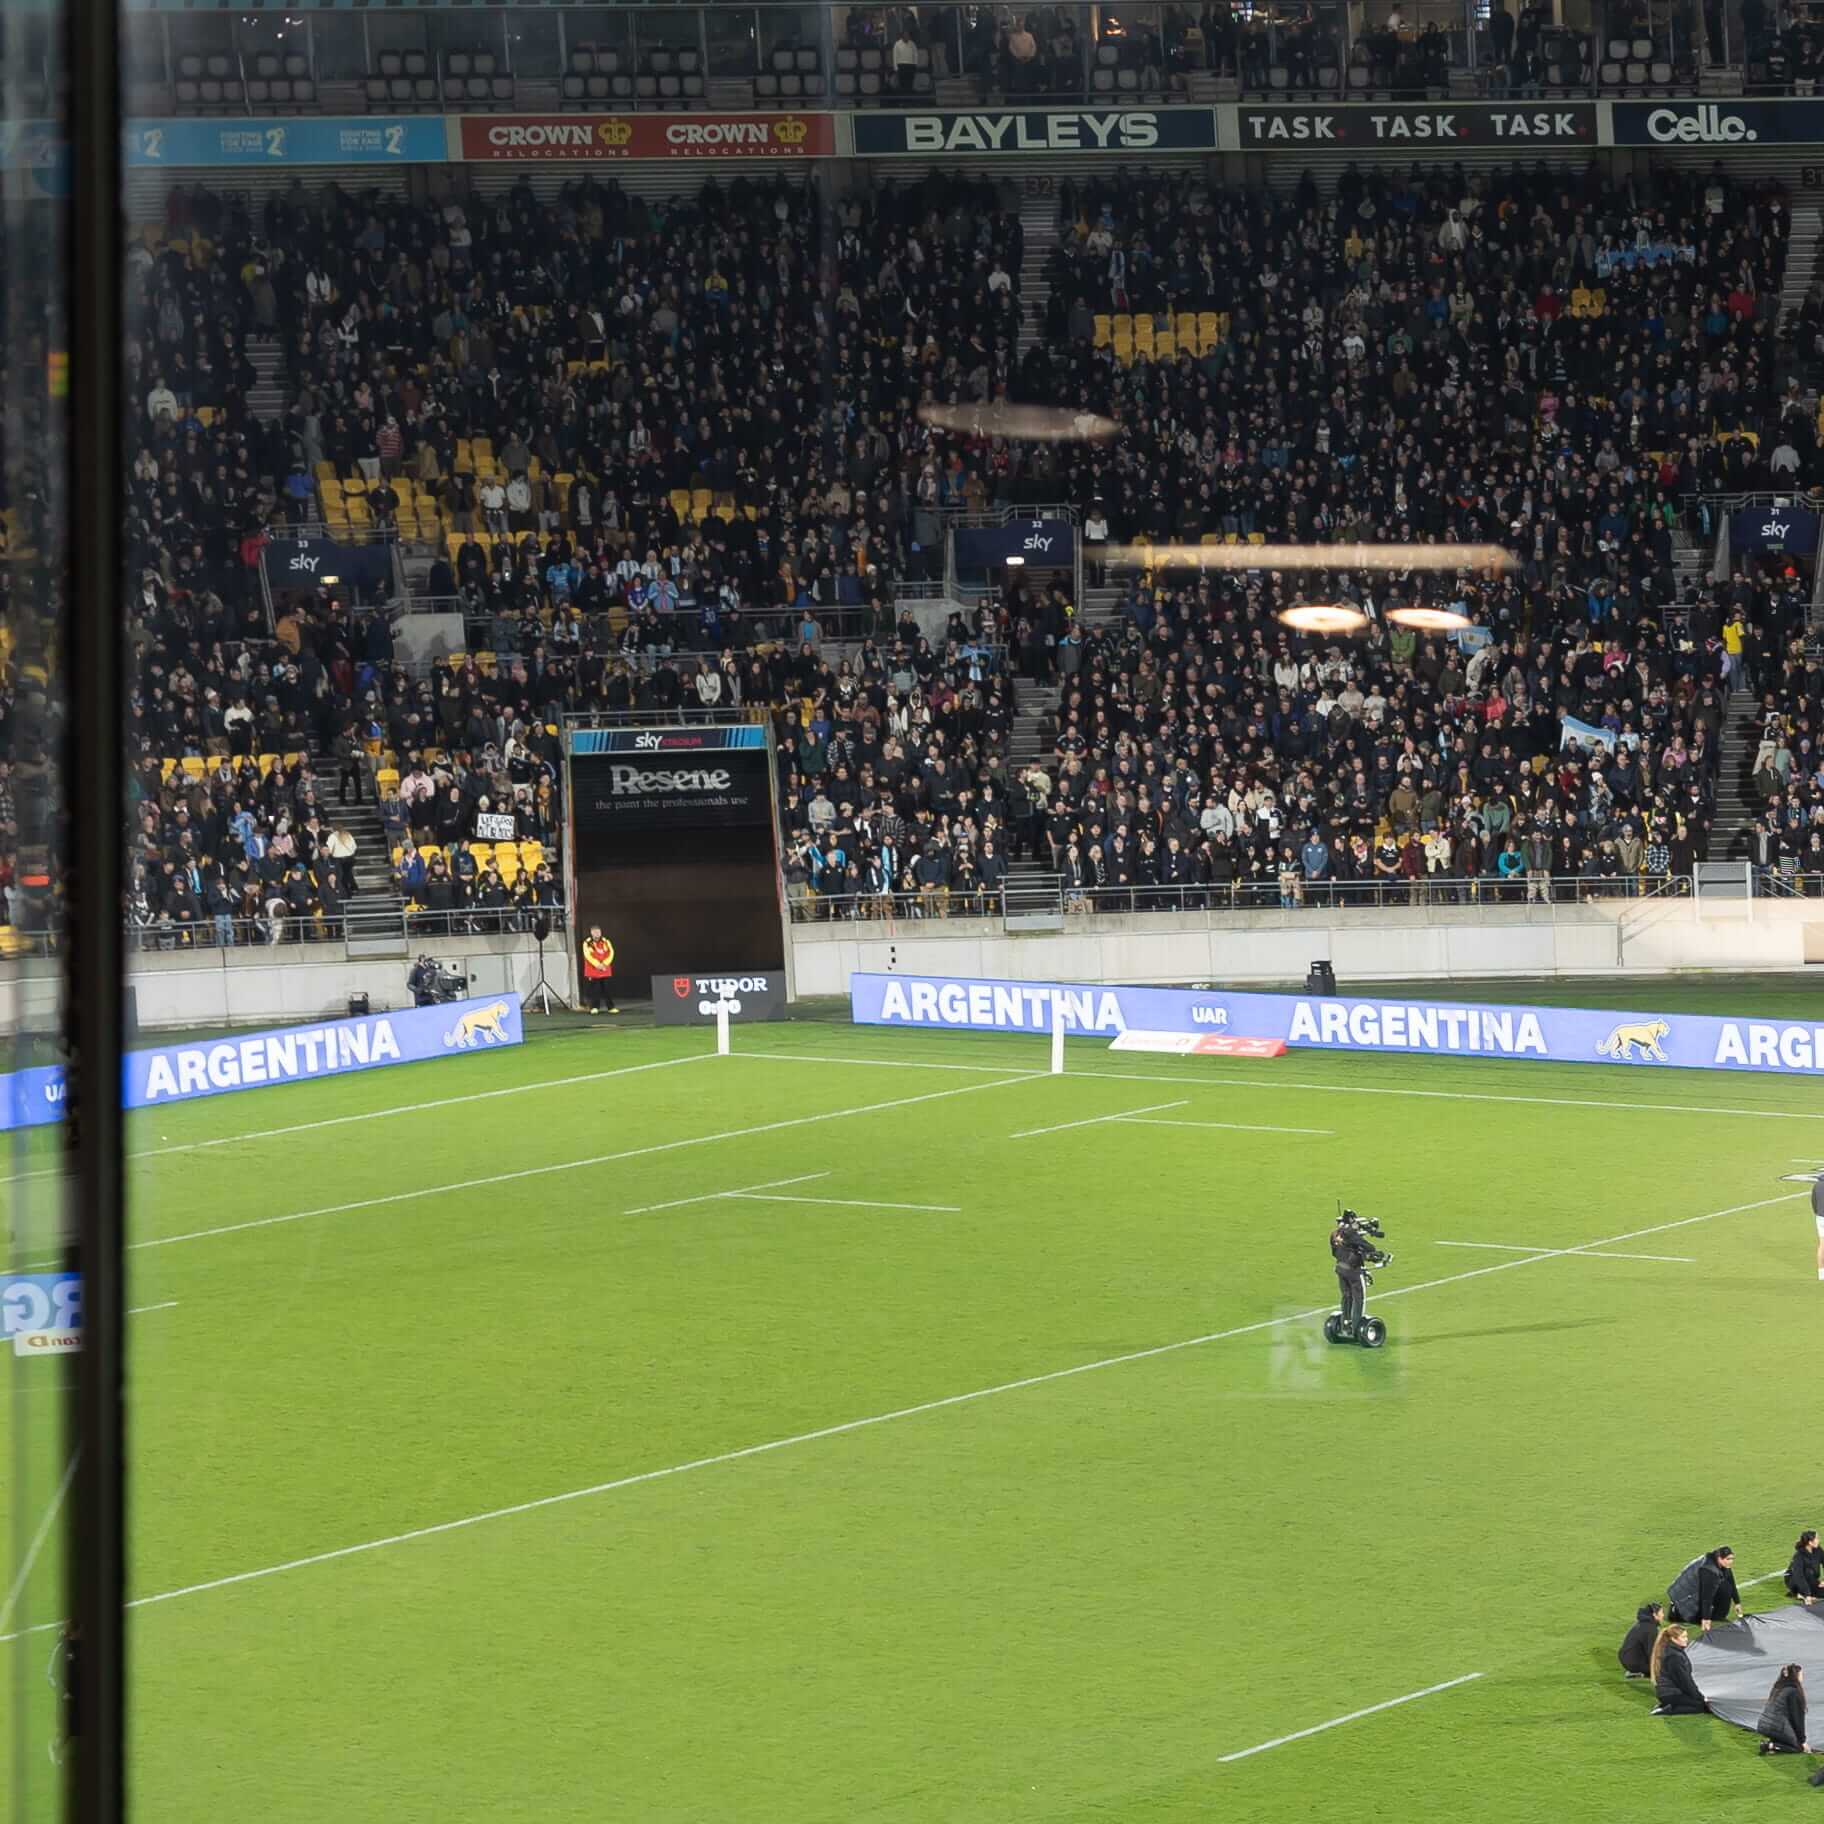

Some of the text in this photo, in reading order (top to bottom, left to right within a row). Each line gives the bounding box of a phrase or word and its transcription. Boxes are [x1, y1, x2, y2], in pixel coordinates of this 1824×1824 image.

[488, 124, 593, 145] CROWN
[666, 122, 770, 145] CROWN
[904, 112, 1160, 151] BAYLEYS
[493, 149, 630, 158] RELOCATIONS
[670, 146, 805, 156] RELOCATIONS
[1024, 176, 1054, 194] 32
[1760, 520, 1790, 539] sky
[1023, 533, 1053, 552] sky
[289, 553, 320, 573] sky
[635, 732, 663, 750] sky
[609, 764, 732, 795] Resene
[695, 977, 768, 994] TUDOR
[882, 980, 1127, 1032] ARGENTINA
[1191, 1007, 1228, 1025] UAR
[1288, 1001, 1548, 1054] ARGENTINA
[146, 1018, 401, 1099] ARGENTINA
